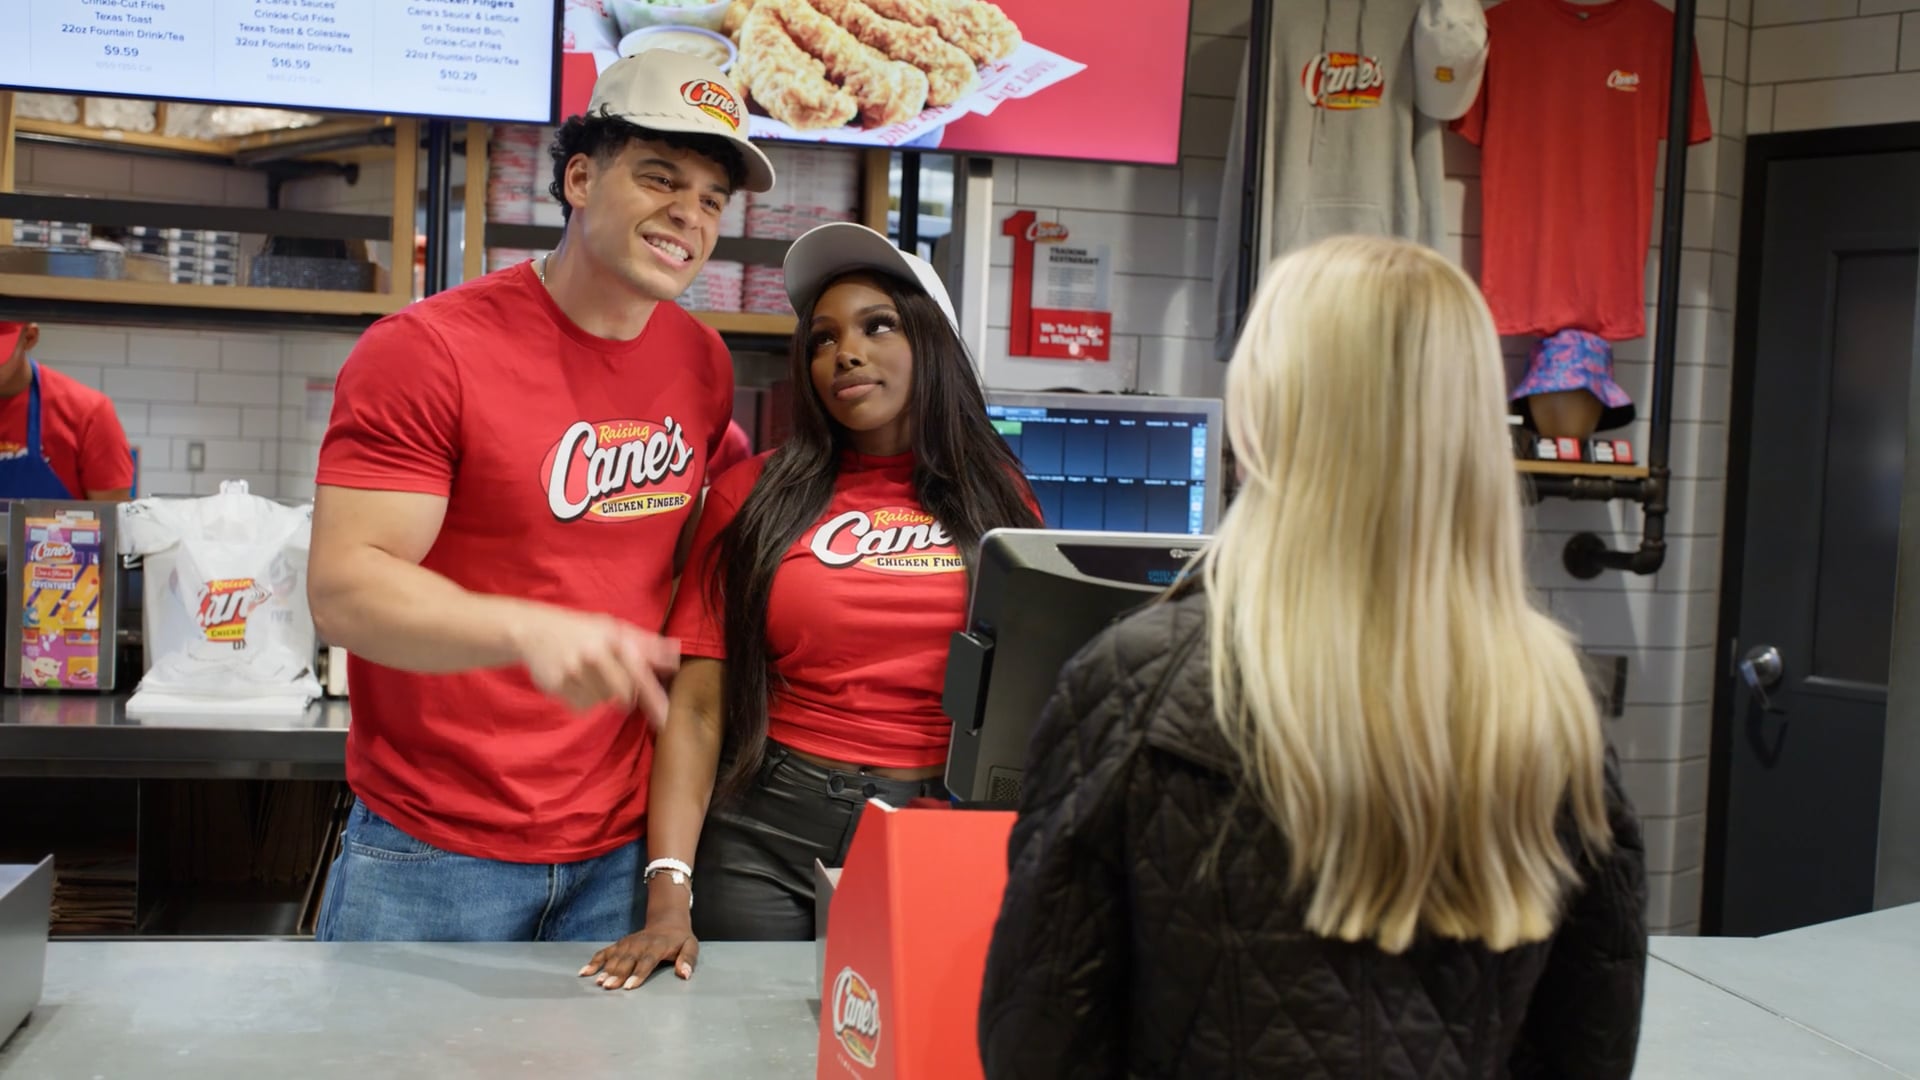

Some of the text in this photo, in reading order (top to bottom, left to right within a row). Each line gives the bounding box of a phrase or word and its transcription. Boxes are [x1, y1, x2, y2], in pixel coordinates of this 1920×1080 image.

[141, 1, 166, 11] Fries
[95, 11, 153, 24] Texas Toast
[254, 9, 335, 24] Crinkle-Cut Fries
[61, 23, 185, 42] 22oz Fountain Drink/Tea
[240, 22, 350, 40] Texas Toast & Coleslaw
[421, 24, 434, 32] on
[445, 23, 481, 35] Toasted
[104, 45, 140, 58] $9.59
[235, 37, 353, 54] 32oz Fountain Drink/Tea
[479, 40, 502, 51] Fries
[271, 57, 311, 70] $16.59
[431, 51, 473, 63] Fountain
[439, 68, 478, 81] $10.29
[599, 421, 651, 444] Raising
[548, 415, 694, 521] Cane's
[602, 495, 686, 514] CHICKEN FINGERS
[873, 509, 934, 527] Raising
[810, 510, 953, 567] Cane
[877, 557, 965, 567] CHICKEN FING
